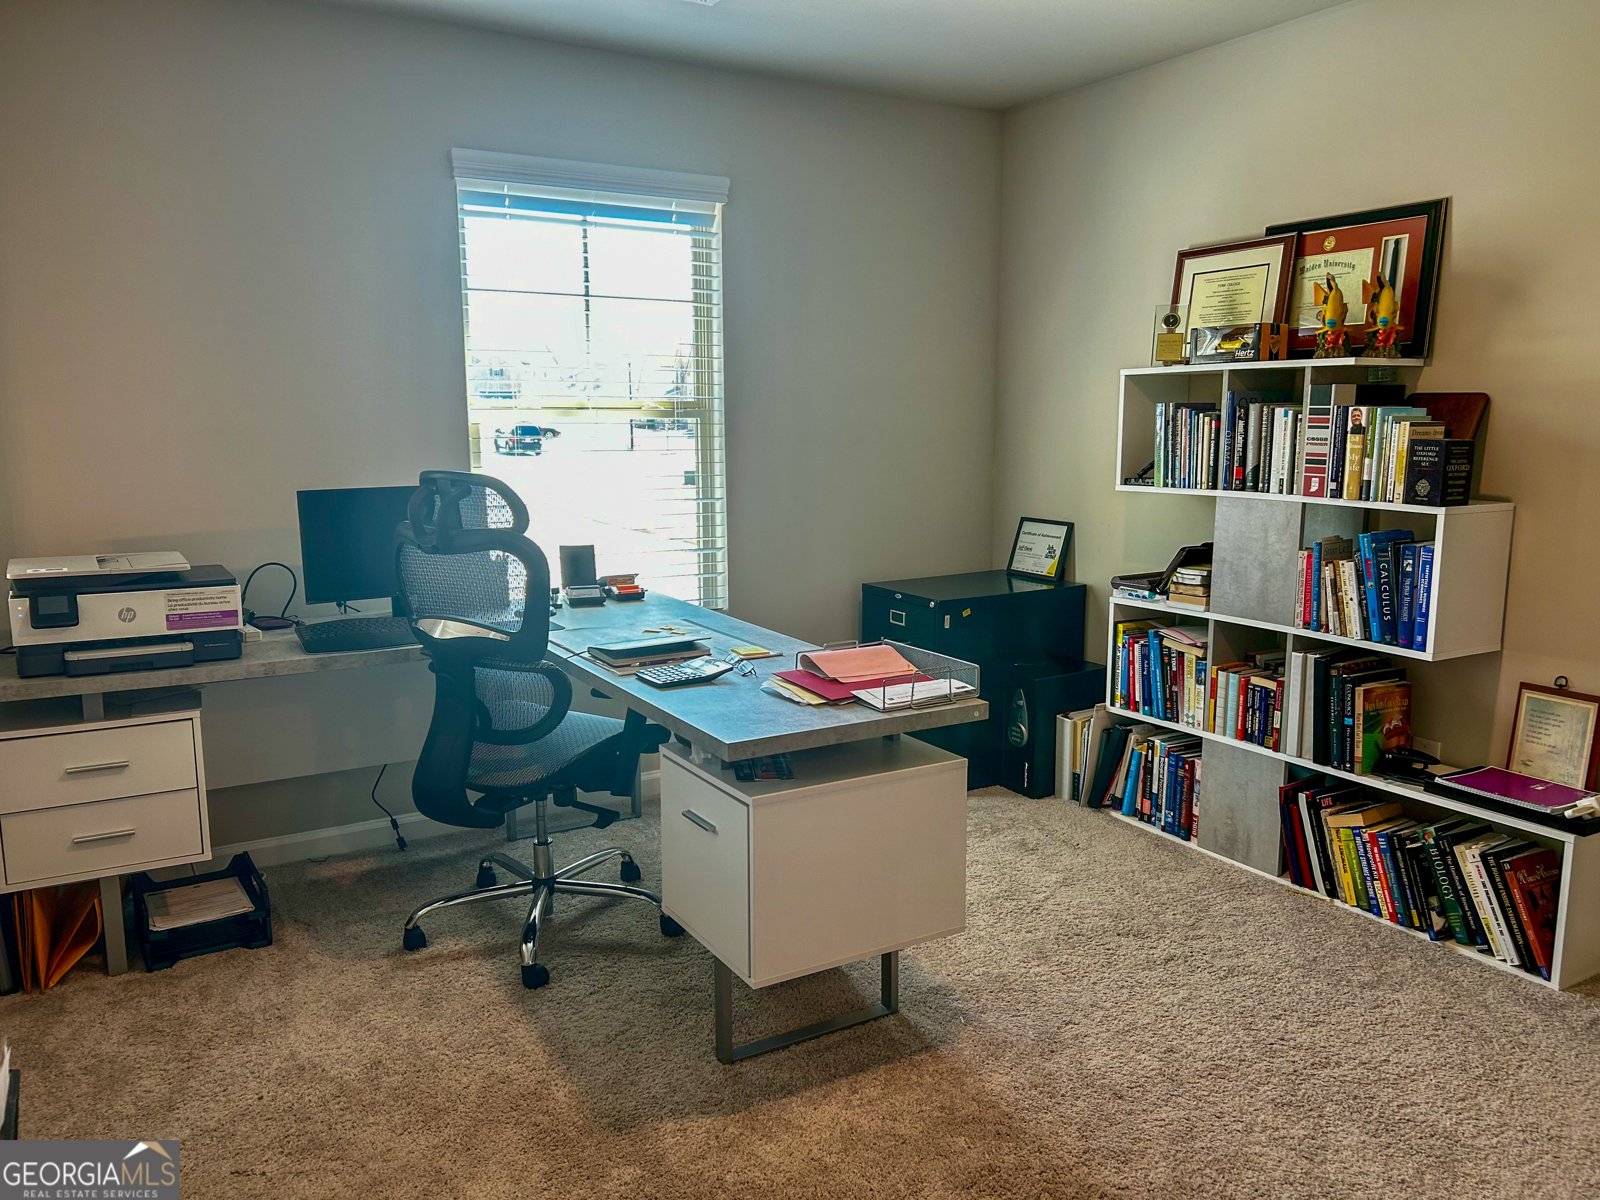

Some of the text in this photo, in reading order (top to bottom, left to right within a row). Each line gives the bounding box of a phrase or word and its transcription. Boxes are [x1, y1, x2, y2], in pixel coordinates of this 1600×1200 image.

[1300, 259, 1356, 274] Walden University
[1235, 349, 1255, 357] Hertz
[1224, 430, 1232, 466] OBAMA
[1378, 563, 1394, 621] CALCULUS
[121, 607, 135, 622] hp
[1321, 797, 1333, 806] LIFE
[1191, 816, 1199, 835] BIBLE
[1355, 836, 1365, 857] MULTIPLE
[1360, 856, 1370, 877] STREAMS
[1366, 880, 1375, 898] INCOME
[1364, 842, 1377, 871] Nonprofit
[1428, 847, 1456, 903] BIOLOGY
[1465, 870, 1481, 899] Sociology
[1449, 864, 1463, 890] Handbook
[1461, 896, 1470, 911] Stress
[1466, 911, 1477, 931] Science
[1487, 856, 1525, 945] THE BOOK OF INSIDE INFORMATION
[1519, 903, 1528, 922] HISTORY
